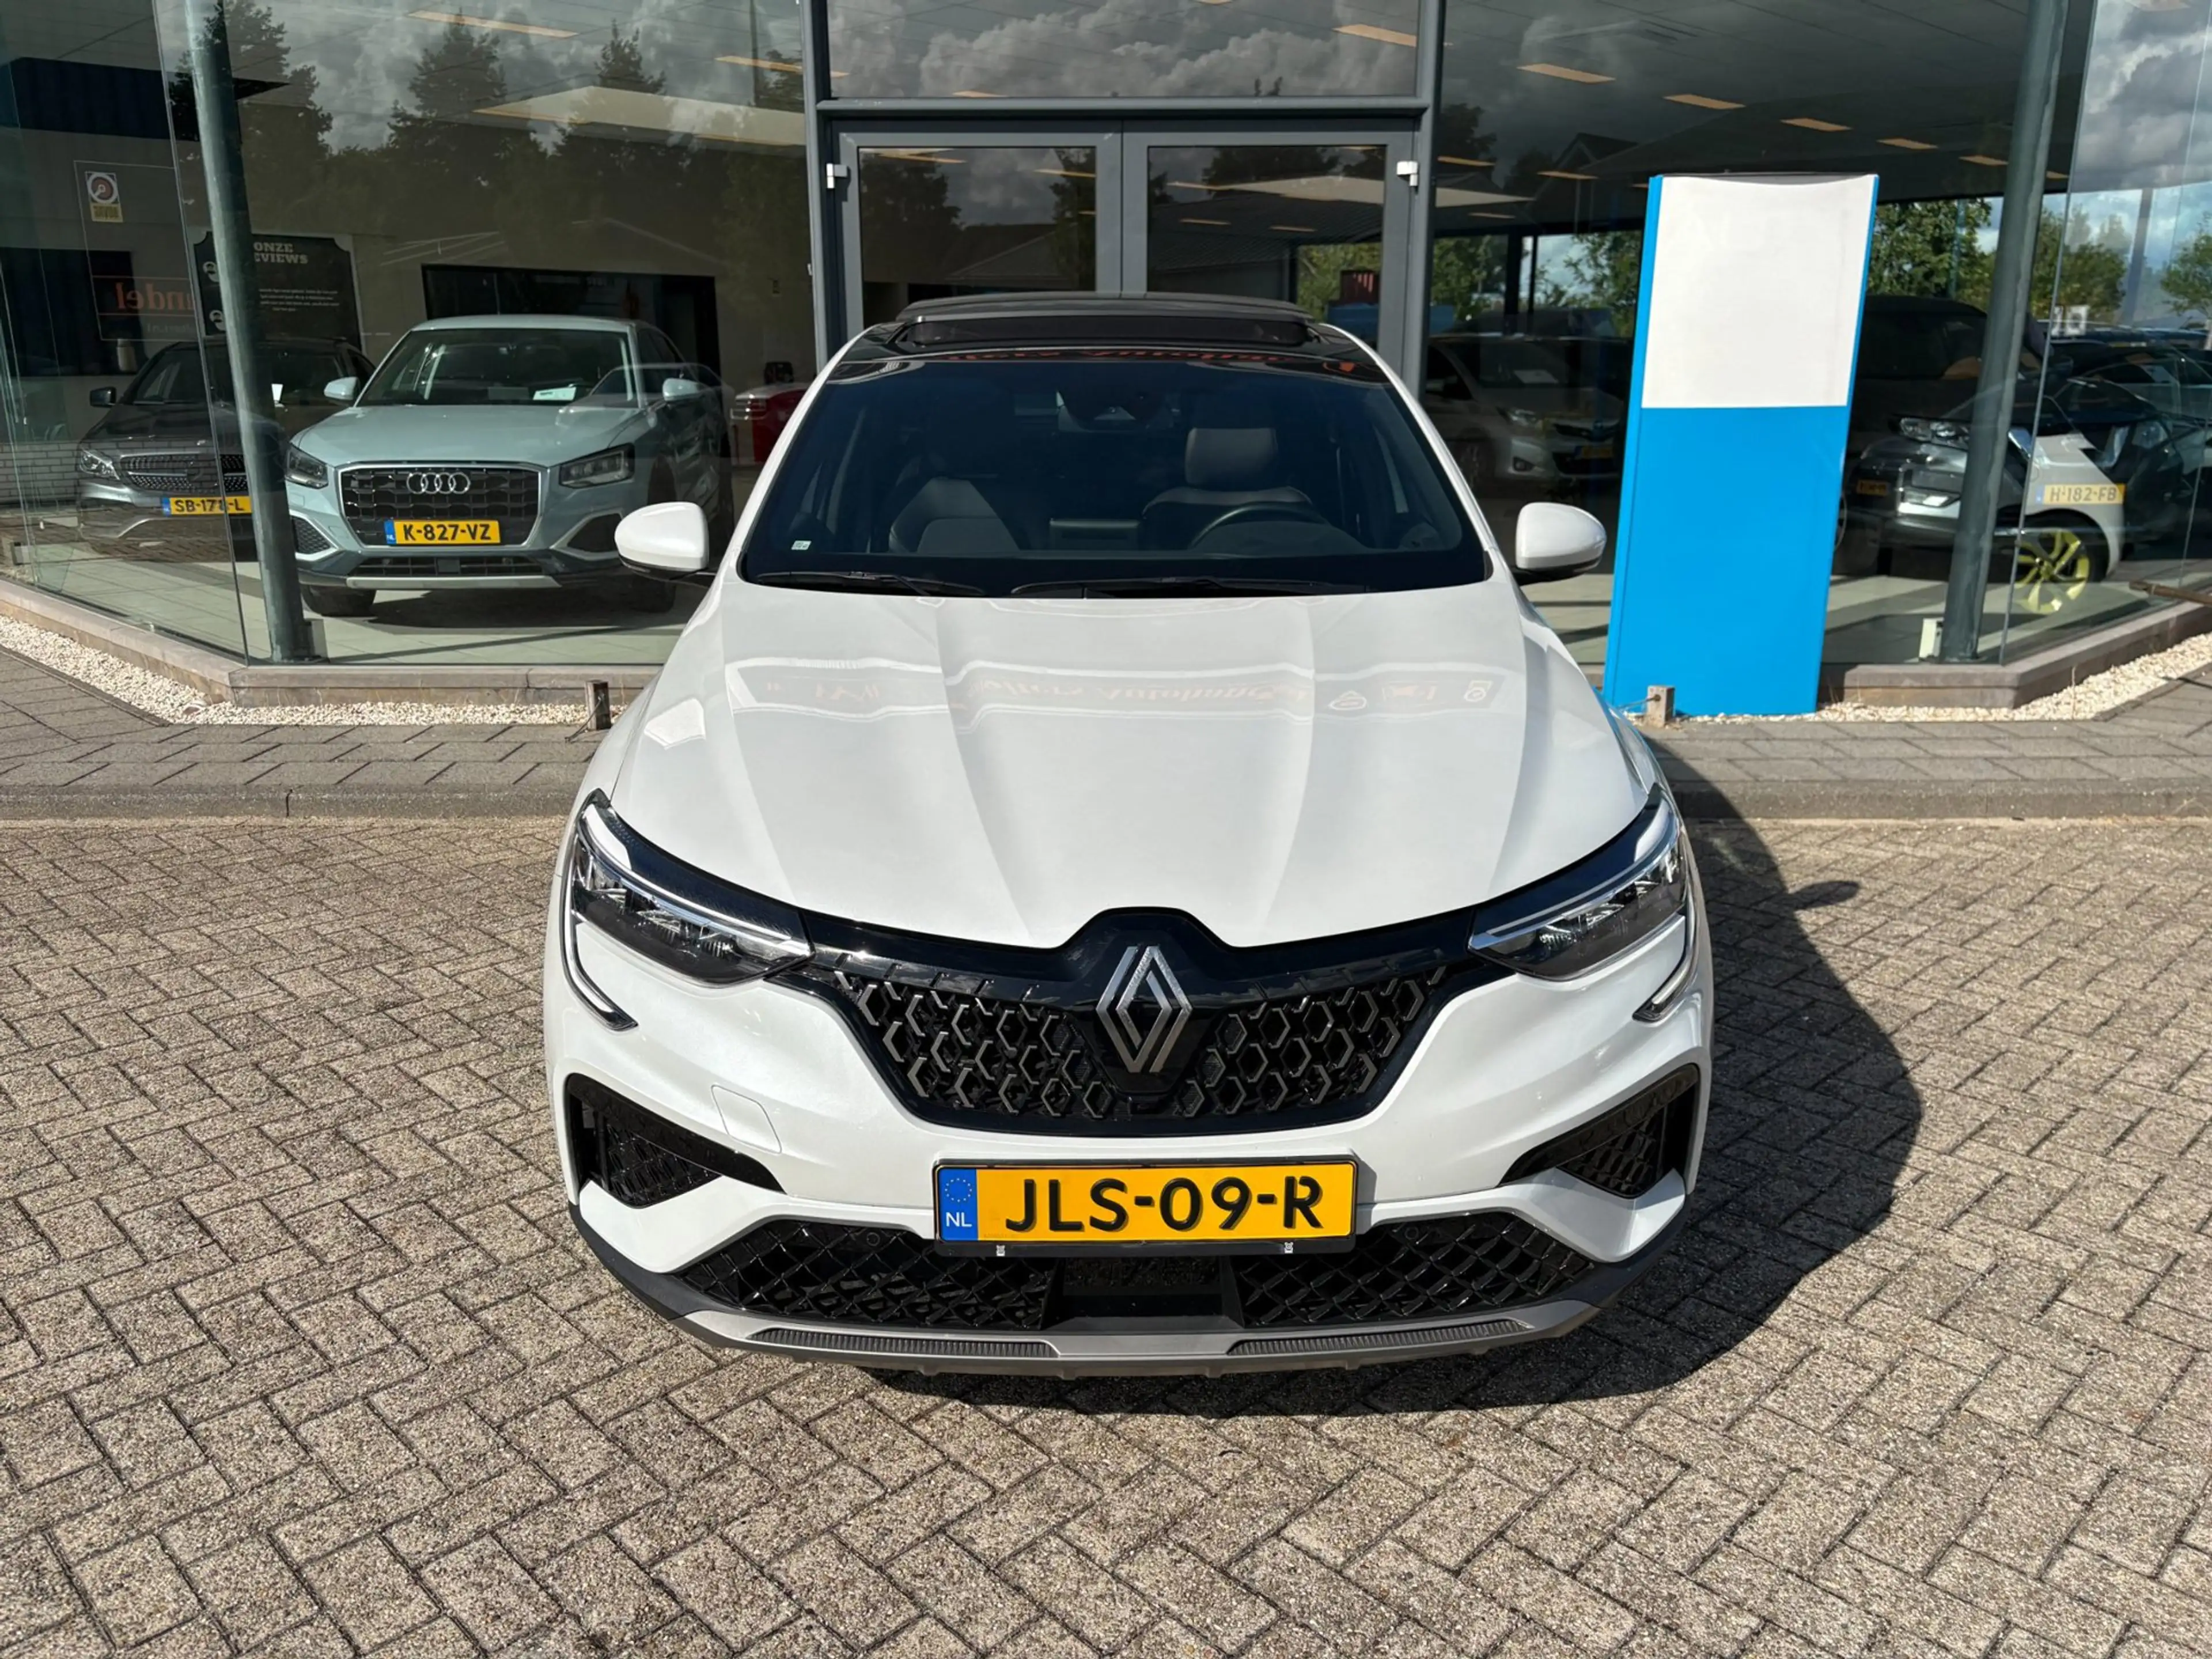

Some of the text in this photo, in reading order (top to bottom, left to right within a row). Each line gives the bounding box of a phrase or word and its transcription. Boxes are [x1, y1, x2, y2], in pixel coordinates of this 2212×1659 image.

[253, 242, 294, 253] ONZE
[253, 252, 309, 264] EVIEWS
[2050, 487, 2117, 502] H-182-FB
[403, 524, 491, 541] K-827-VZ
[1005, 1176, 1324, 1232] JLS-09-R
[946, 1211, 972, 1227] NL
